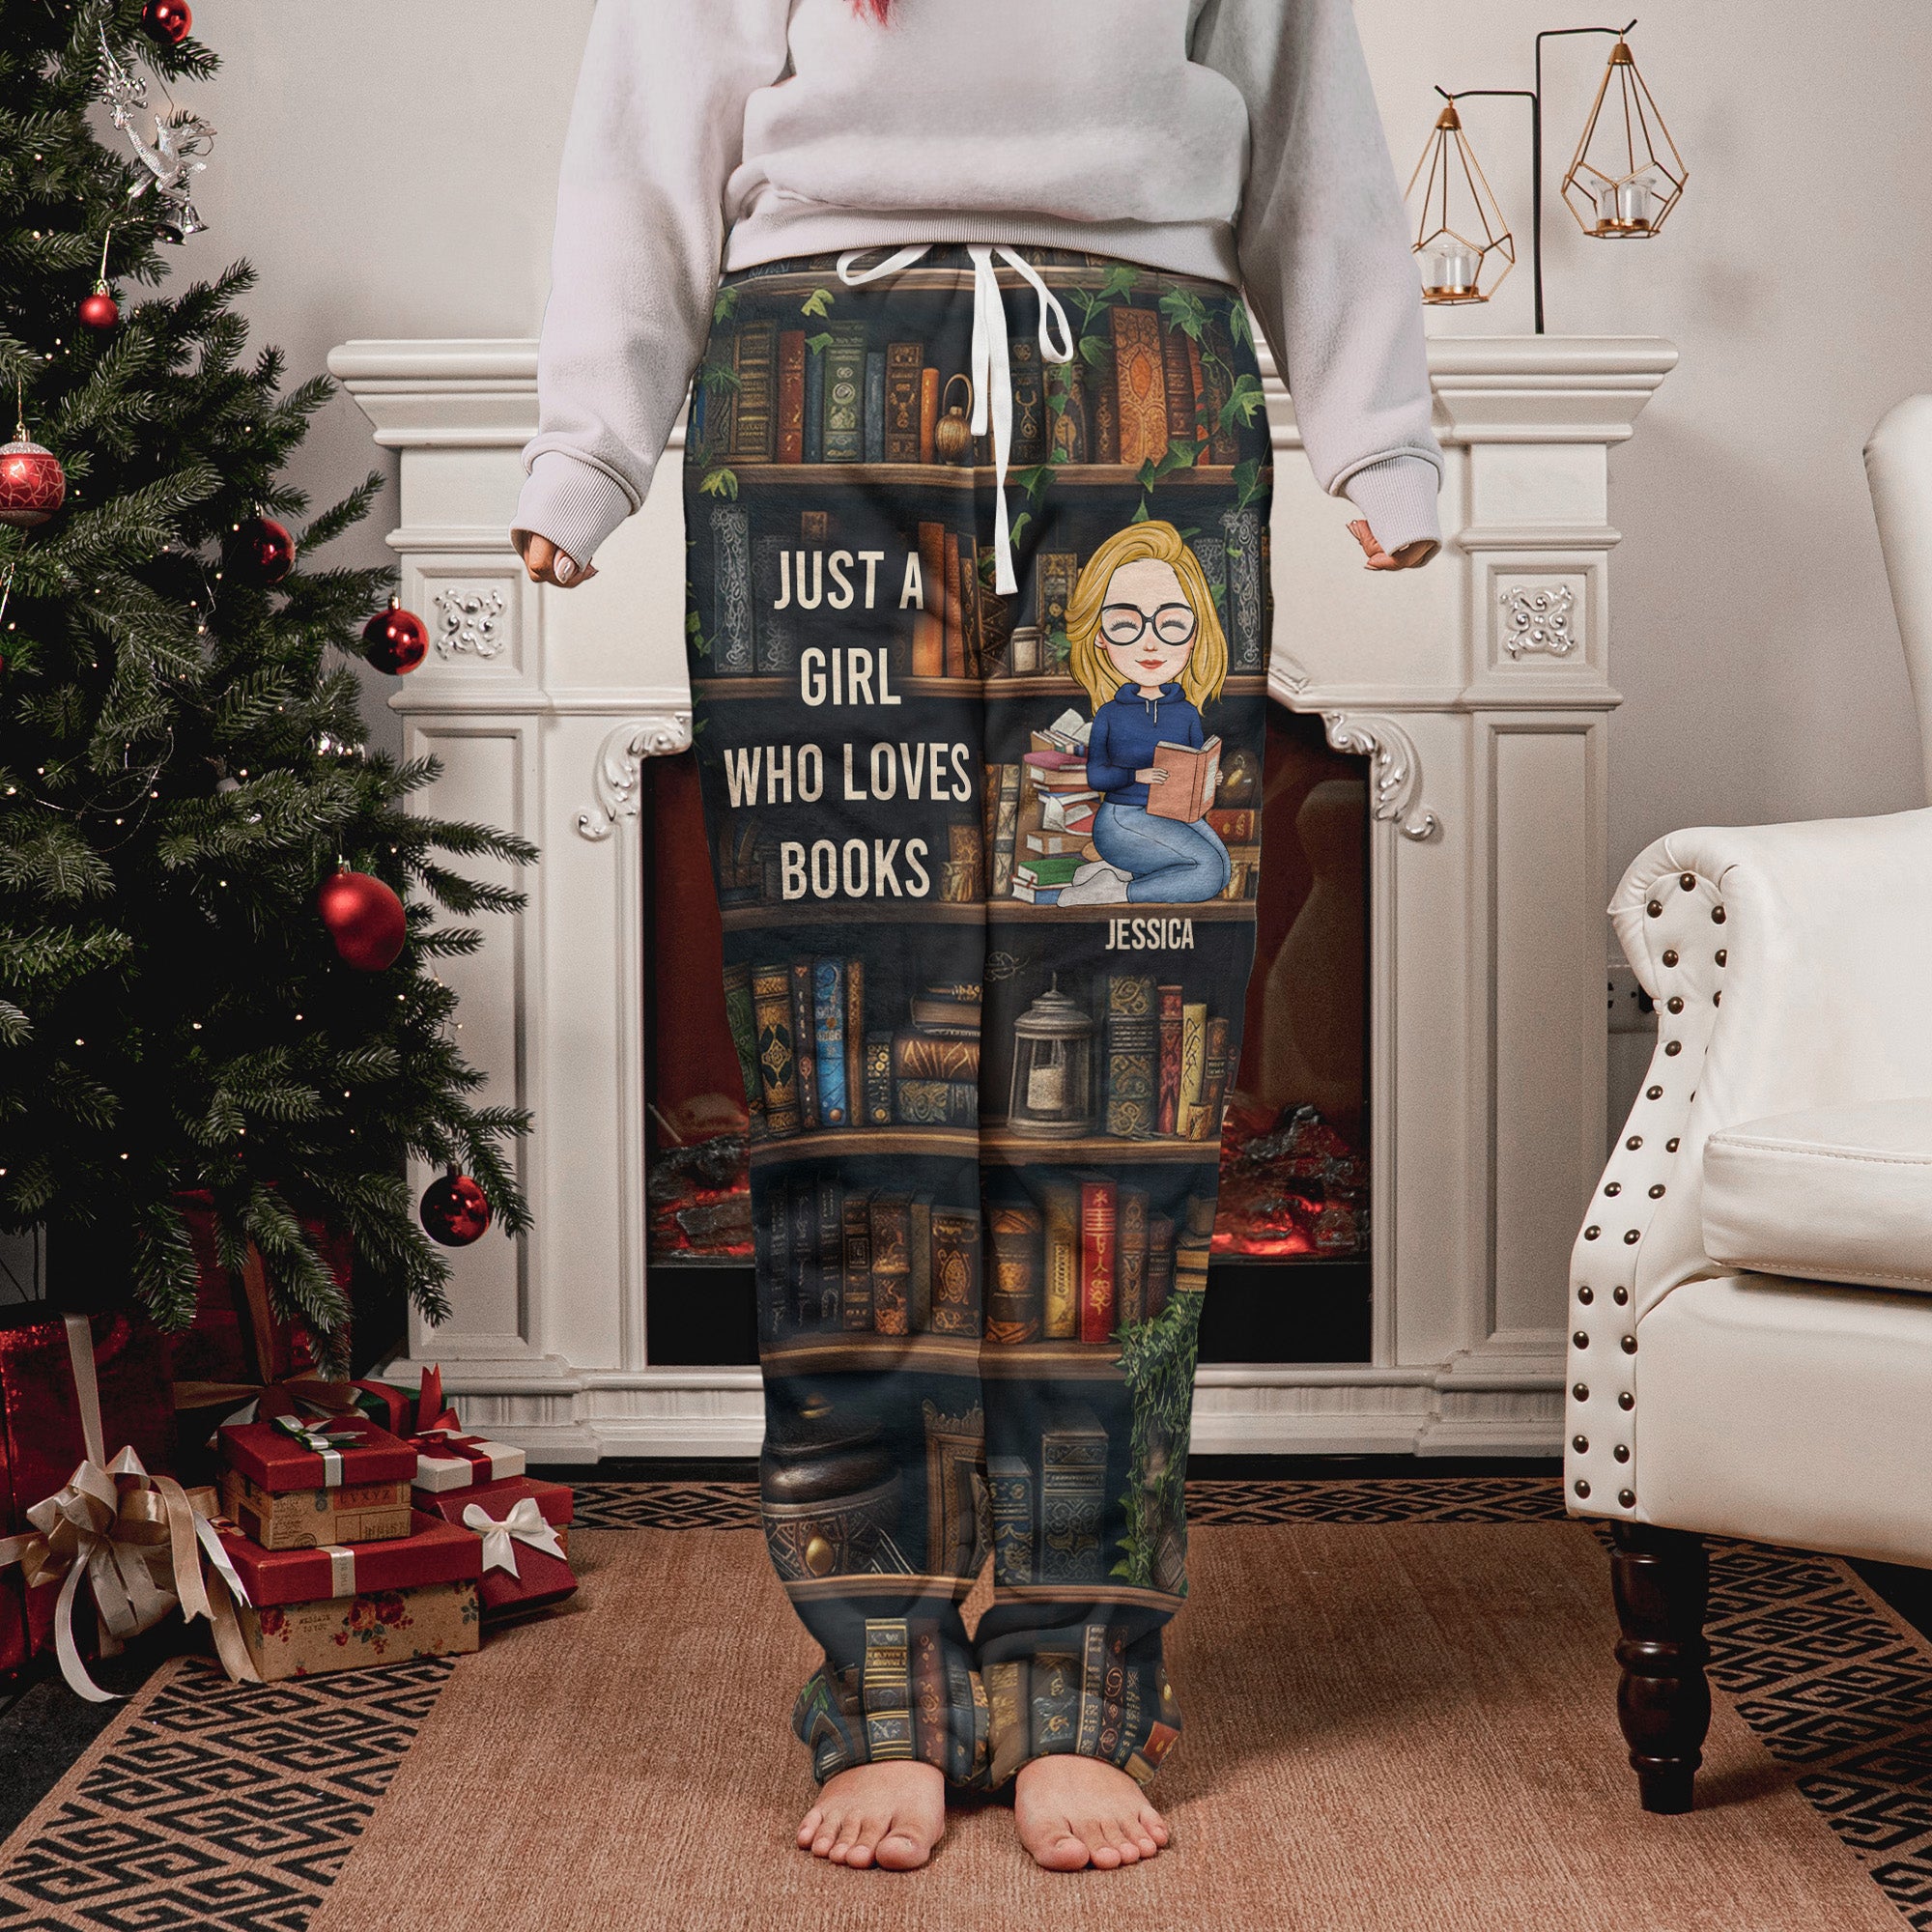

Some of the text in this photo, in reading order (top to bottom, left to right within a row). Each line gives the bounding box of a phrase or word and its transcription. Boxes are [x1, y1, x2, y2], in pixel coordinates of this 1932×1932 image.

[774, 550, 924, 611] JUST A
[800, 646, 902, 707] GIRL
[724, 742, 972, 808] WHO LOVES
[781, 838, 930, 900] BOOKS
[1105, 918, 1195, 951] JESSICA
